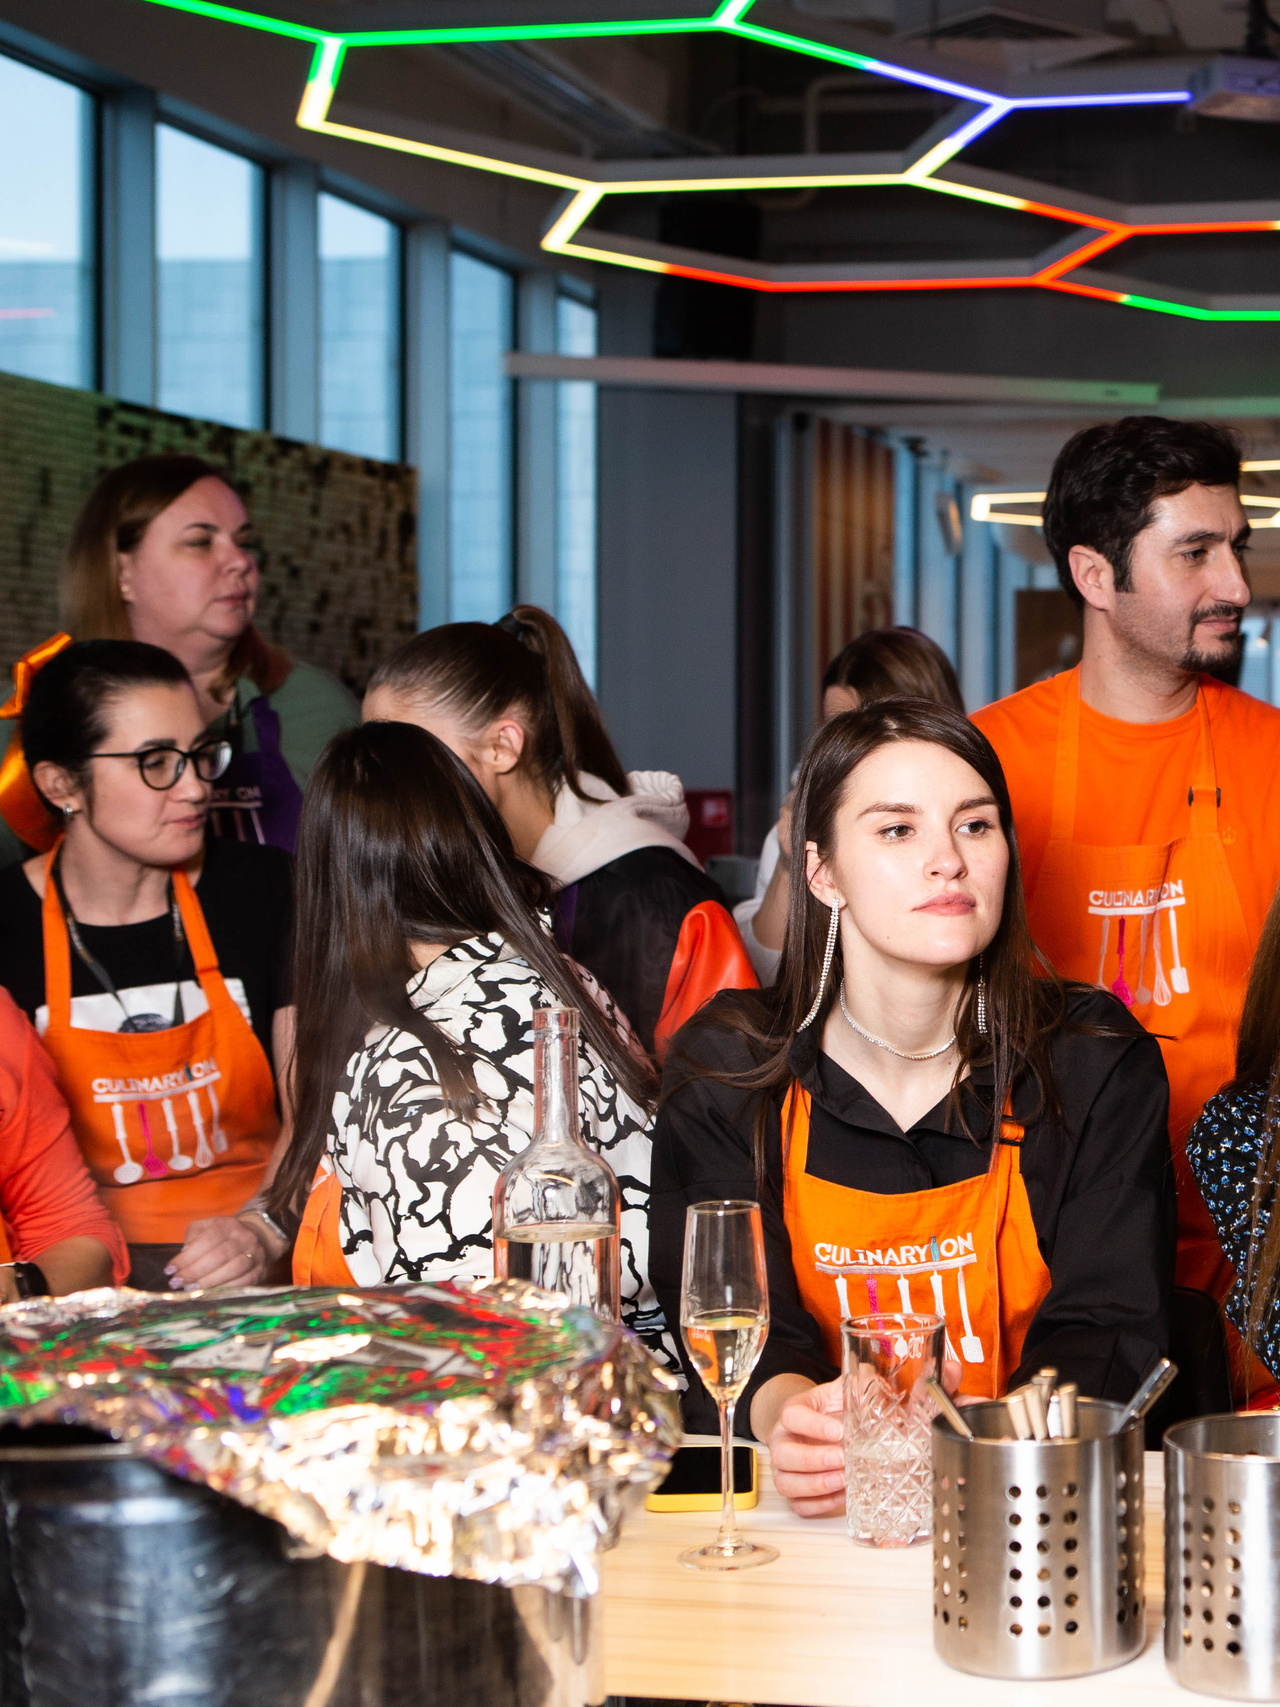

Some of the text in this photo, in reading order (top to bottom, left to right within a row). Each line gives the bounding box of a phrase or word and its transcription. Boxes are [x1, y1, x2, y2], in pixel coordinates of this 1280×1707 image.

[92, 1057, 217, 1095] CULINARY ON
[814, 1232, 974, 1266] CULINARY ON
